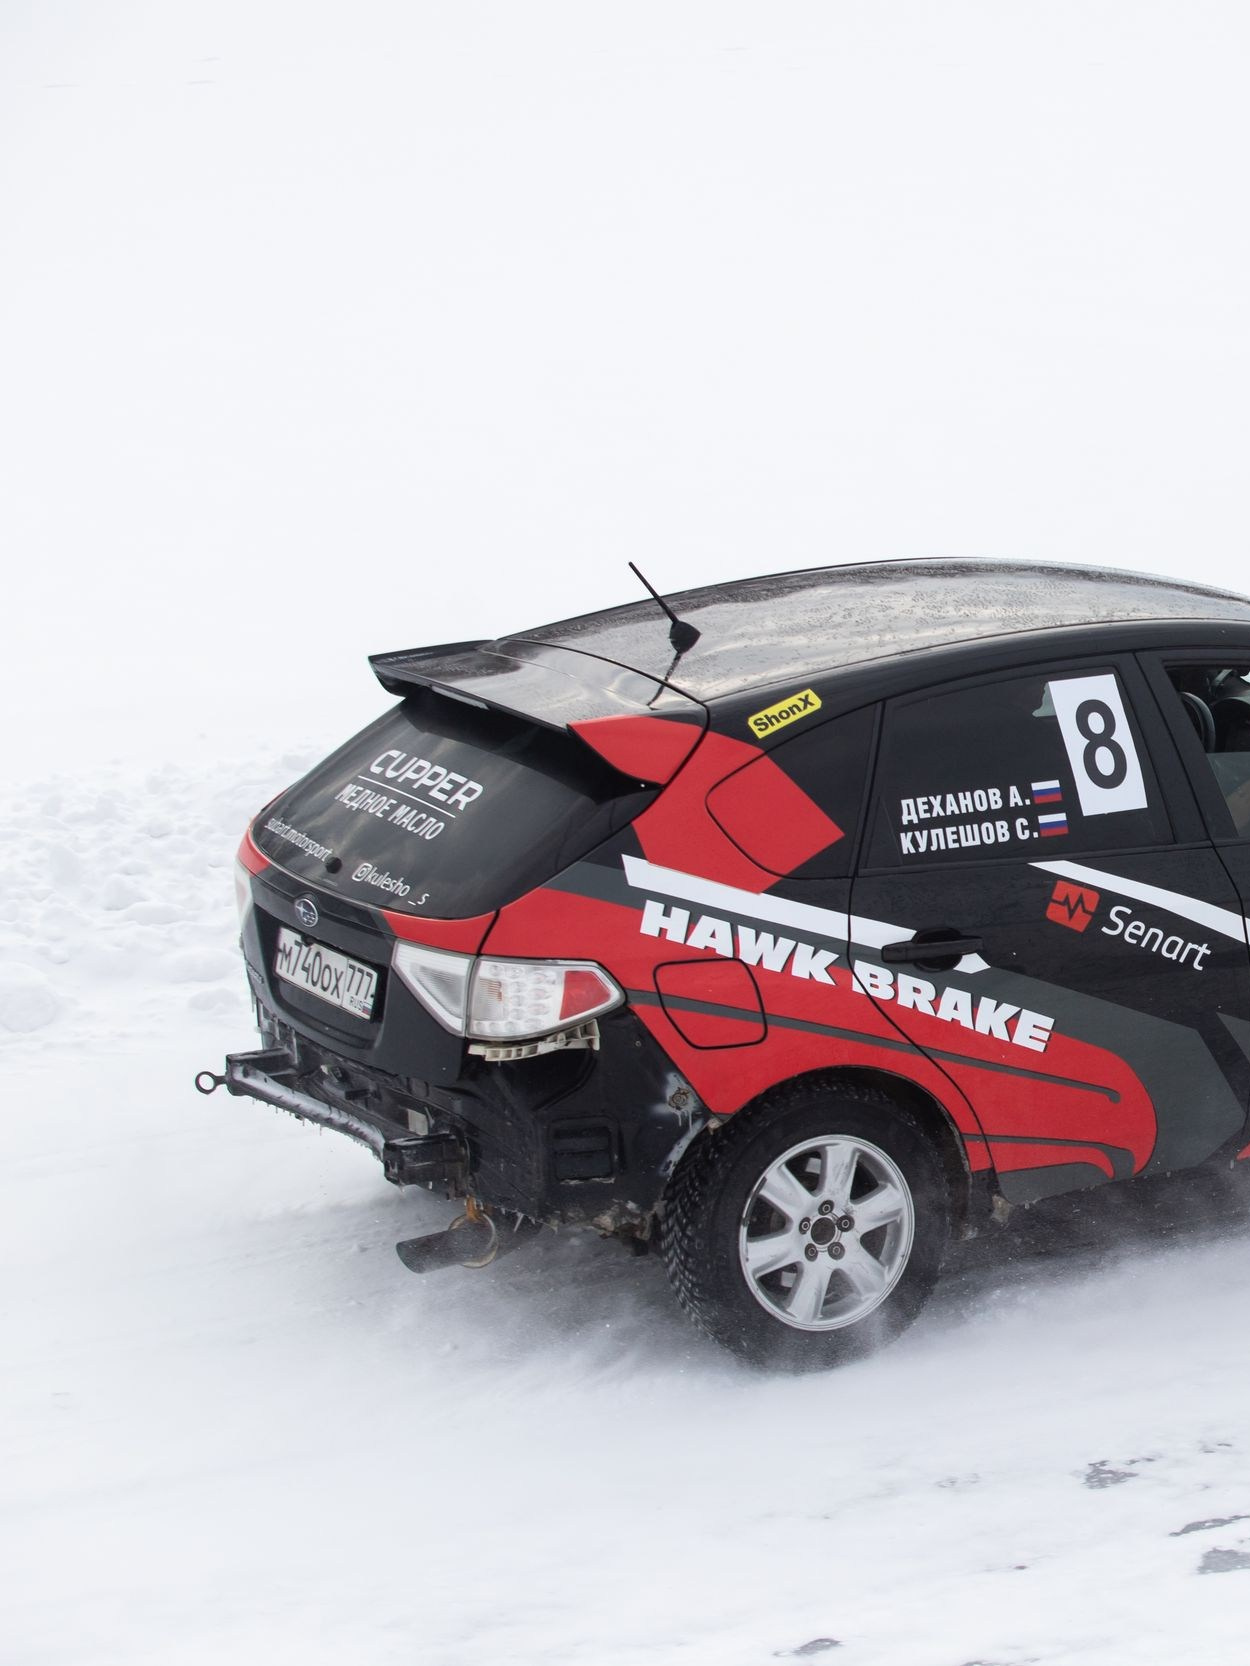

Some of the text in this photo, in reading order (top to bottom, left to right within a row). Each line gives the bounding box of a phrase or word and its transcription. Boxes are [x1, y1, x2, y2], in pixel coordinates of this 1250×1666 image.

[753, 694, 815, 732] ShonX
[1075, 698, 1128, 790] 8
[369, 749, 484, 811] CUPPER
[334, 783, 446, 840] МЕДНОЕ МАСЛО
[900, 785, 1031, 825] ДЕХАНОВ А.
[900, 817, 1039, 855] КУЛЕШОВ С.
[1101, 905, 1211, 971] Senart
[347, 963, 374, 1000] 777
[639, 900, 1055, 1053] HAWK BRAKE
[350, 996, 366, 1011] RUS
